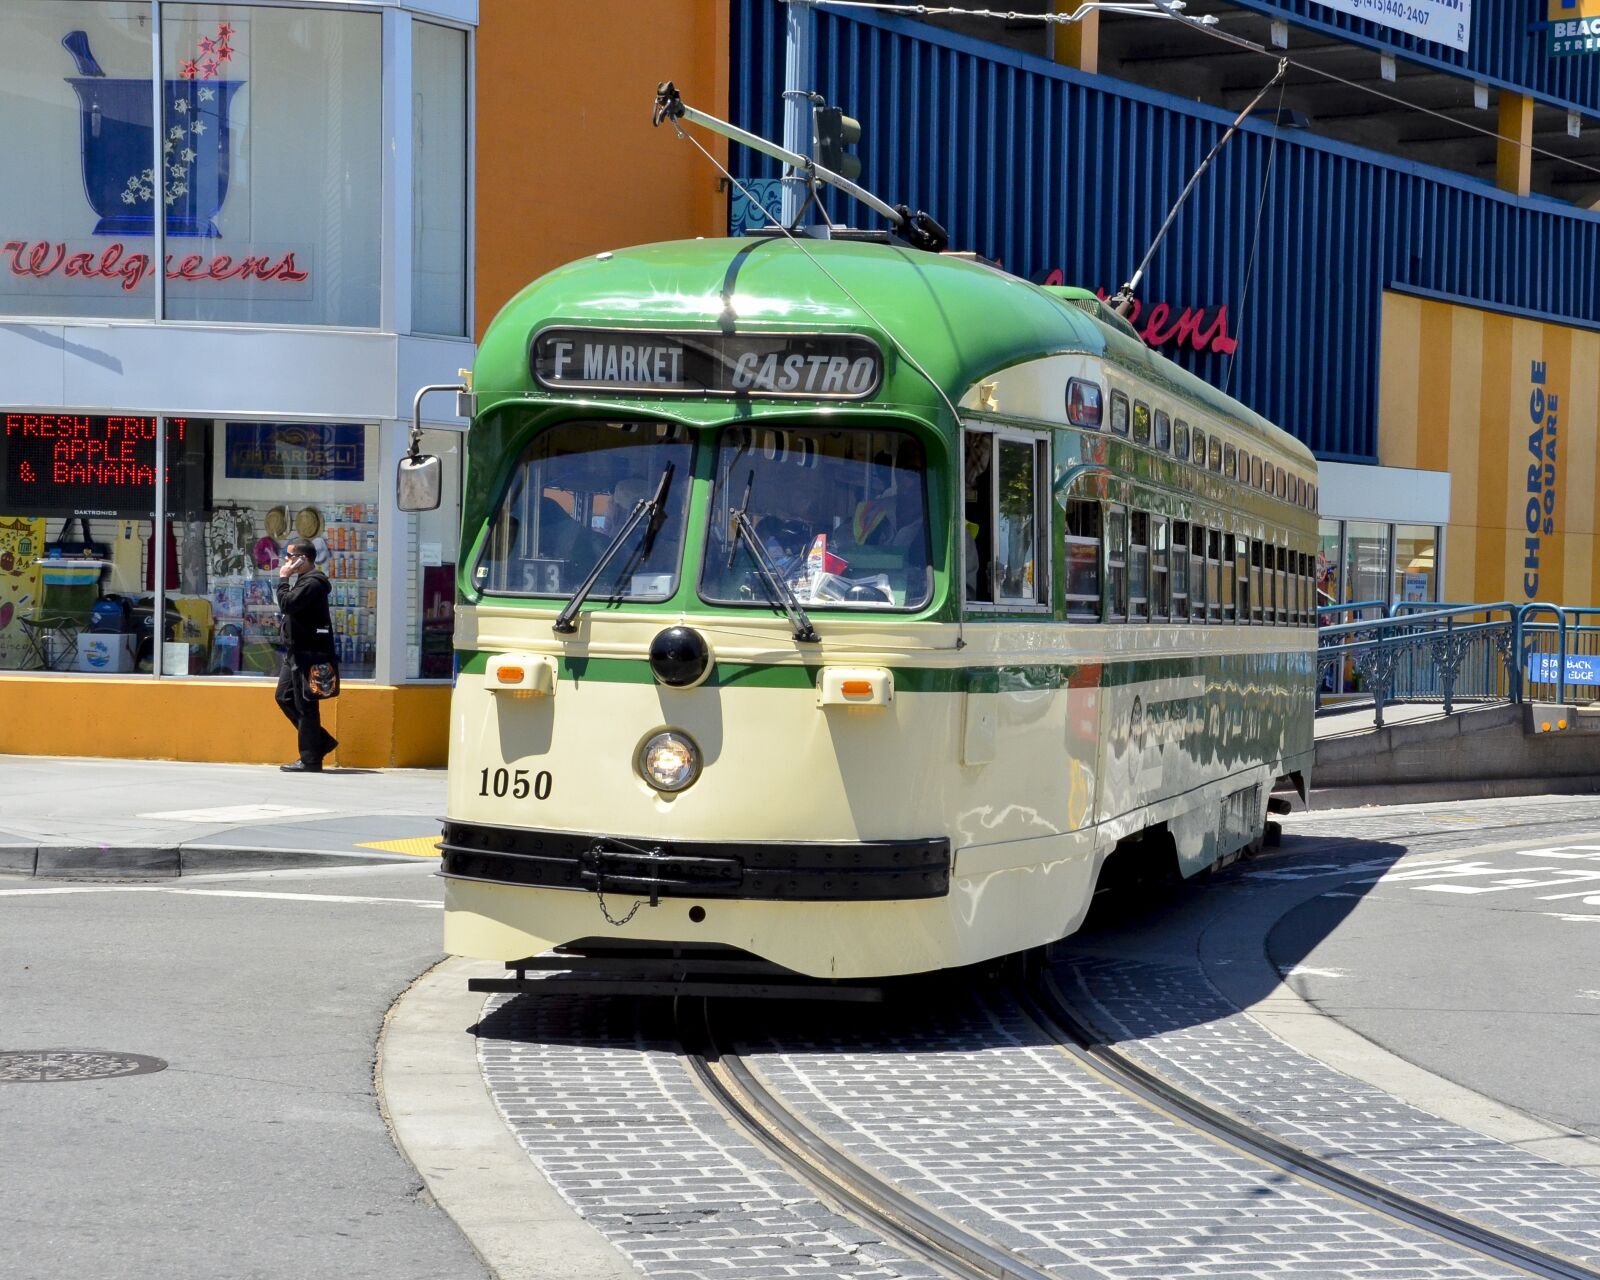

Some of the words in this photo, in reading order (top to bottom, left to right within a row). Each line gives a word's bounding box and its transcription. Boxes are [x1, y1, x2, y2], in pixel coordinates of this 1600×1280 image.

[553, 342, 573, 380] F
[583, 343, 683, 384] MARKET
[731, 351, 875, 393] CASTRO
[6, 415, 90, 438] FRESH
[107, 417, 187, 440] FRUT
[53, 439, 136, 462] APPLE
[1543, 393, 1558, 536] SQUARE
[20, 461, 36, 483] &
[478, 767, 553, 801] 1050
